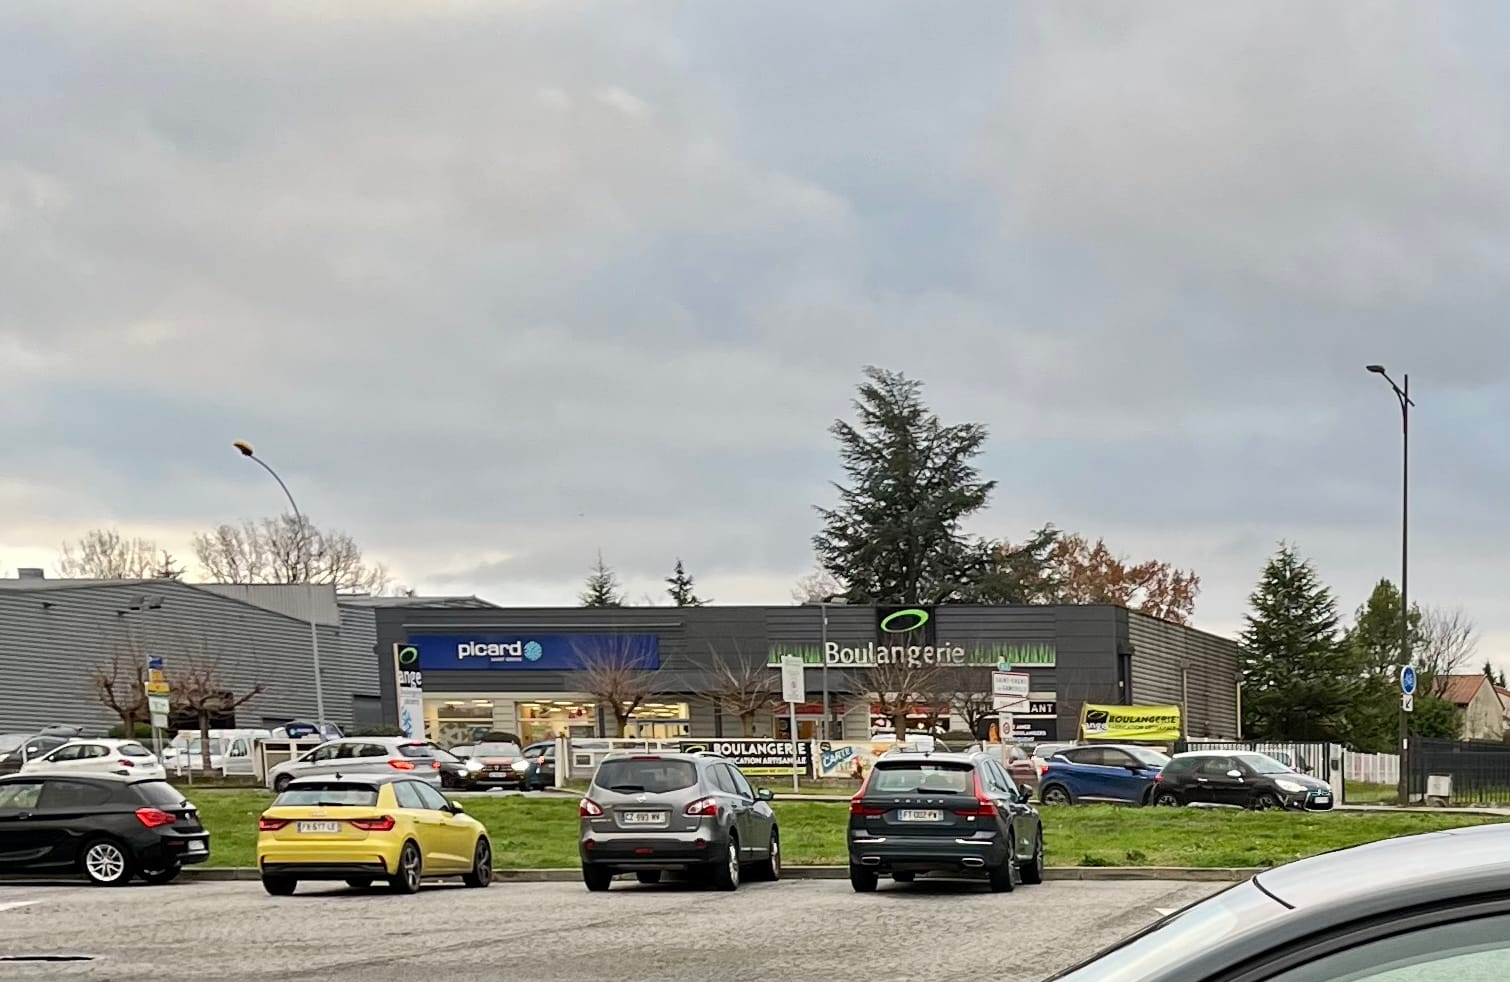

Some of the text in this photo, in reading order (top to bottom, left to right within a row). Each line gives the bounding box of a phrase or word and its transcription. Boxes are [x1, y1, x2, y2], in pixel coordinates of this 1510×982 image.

[458, 641, 522, 660] picard
[826, 641, 965, 669] Boulangerie
[398, 670, 423, 688] ange
[713, 742, 807, 756] BOULANGERE
[823, 746, 853, 768] CARTE
